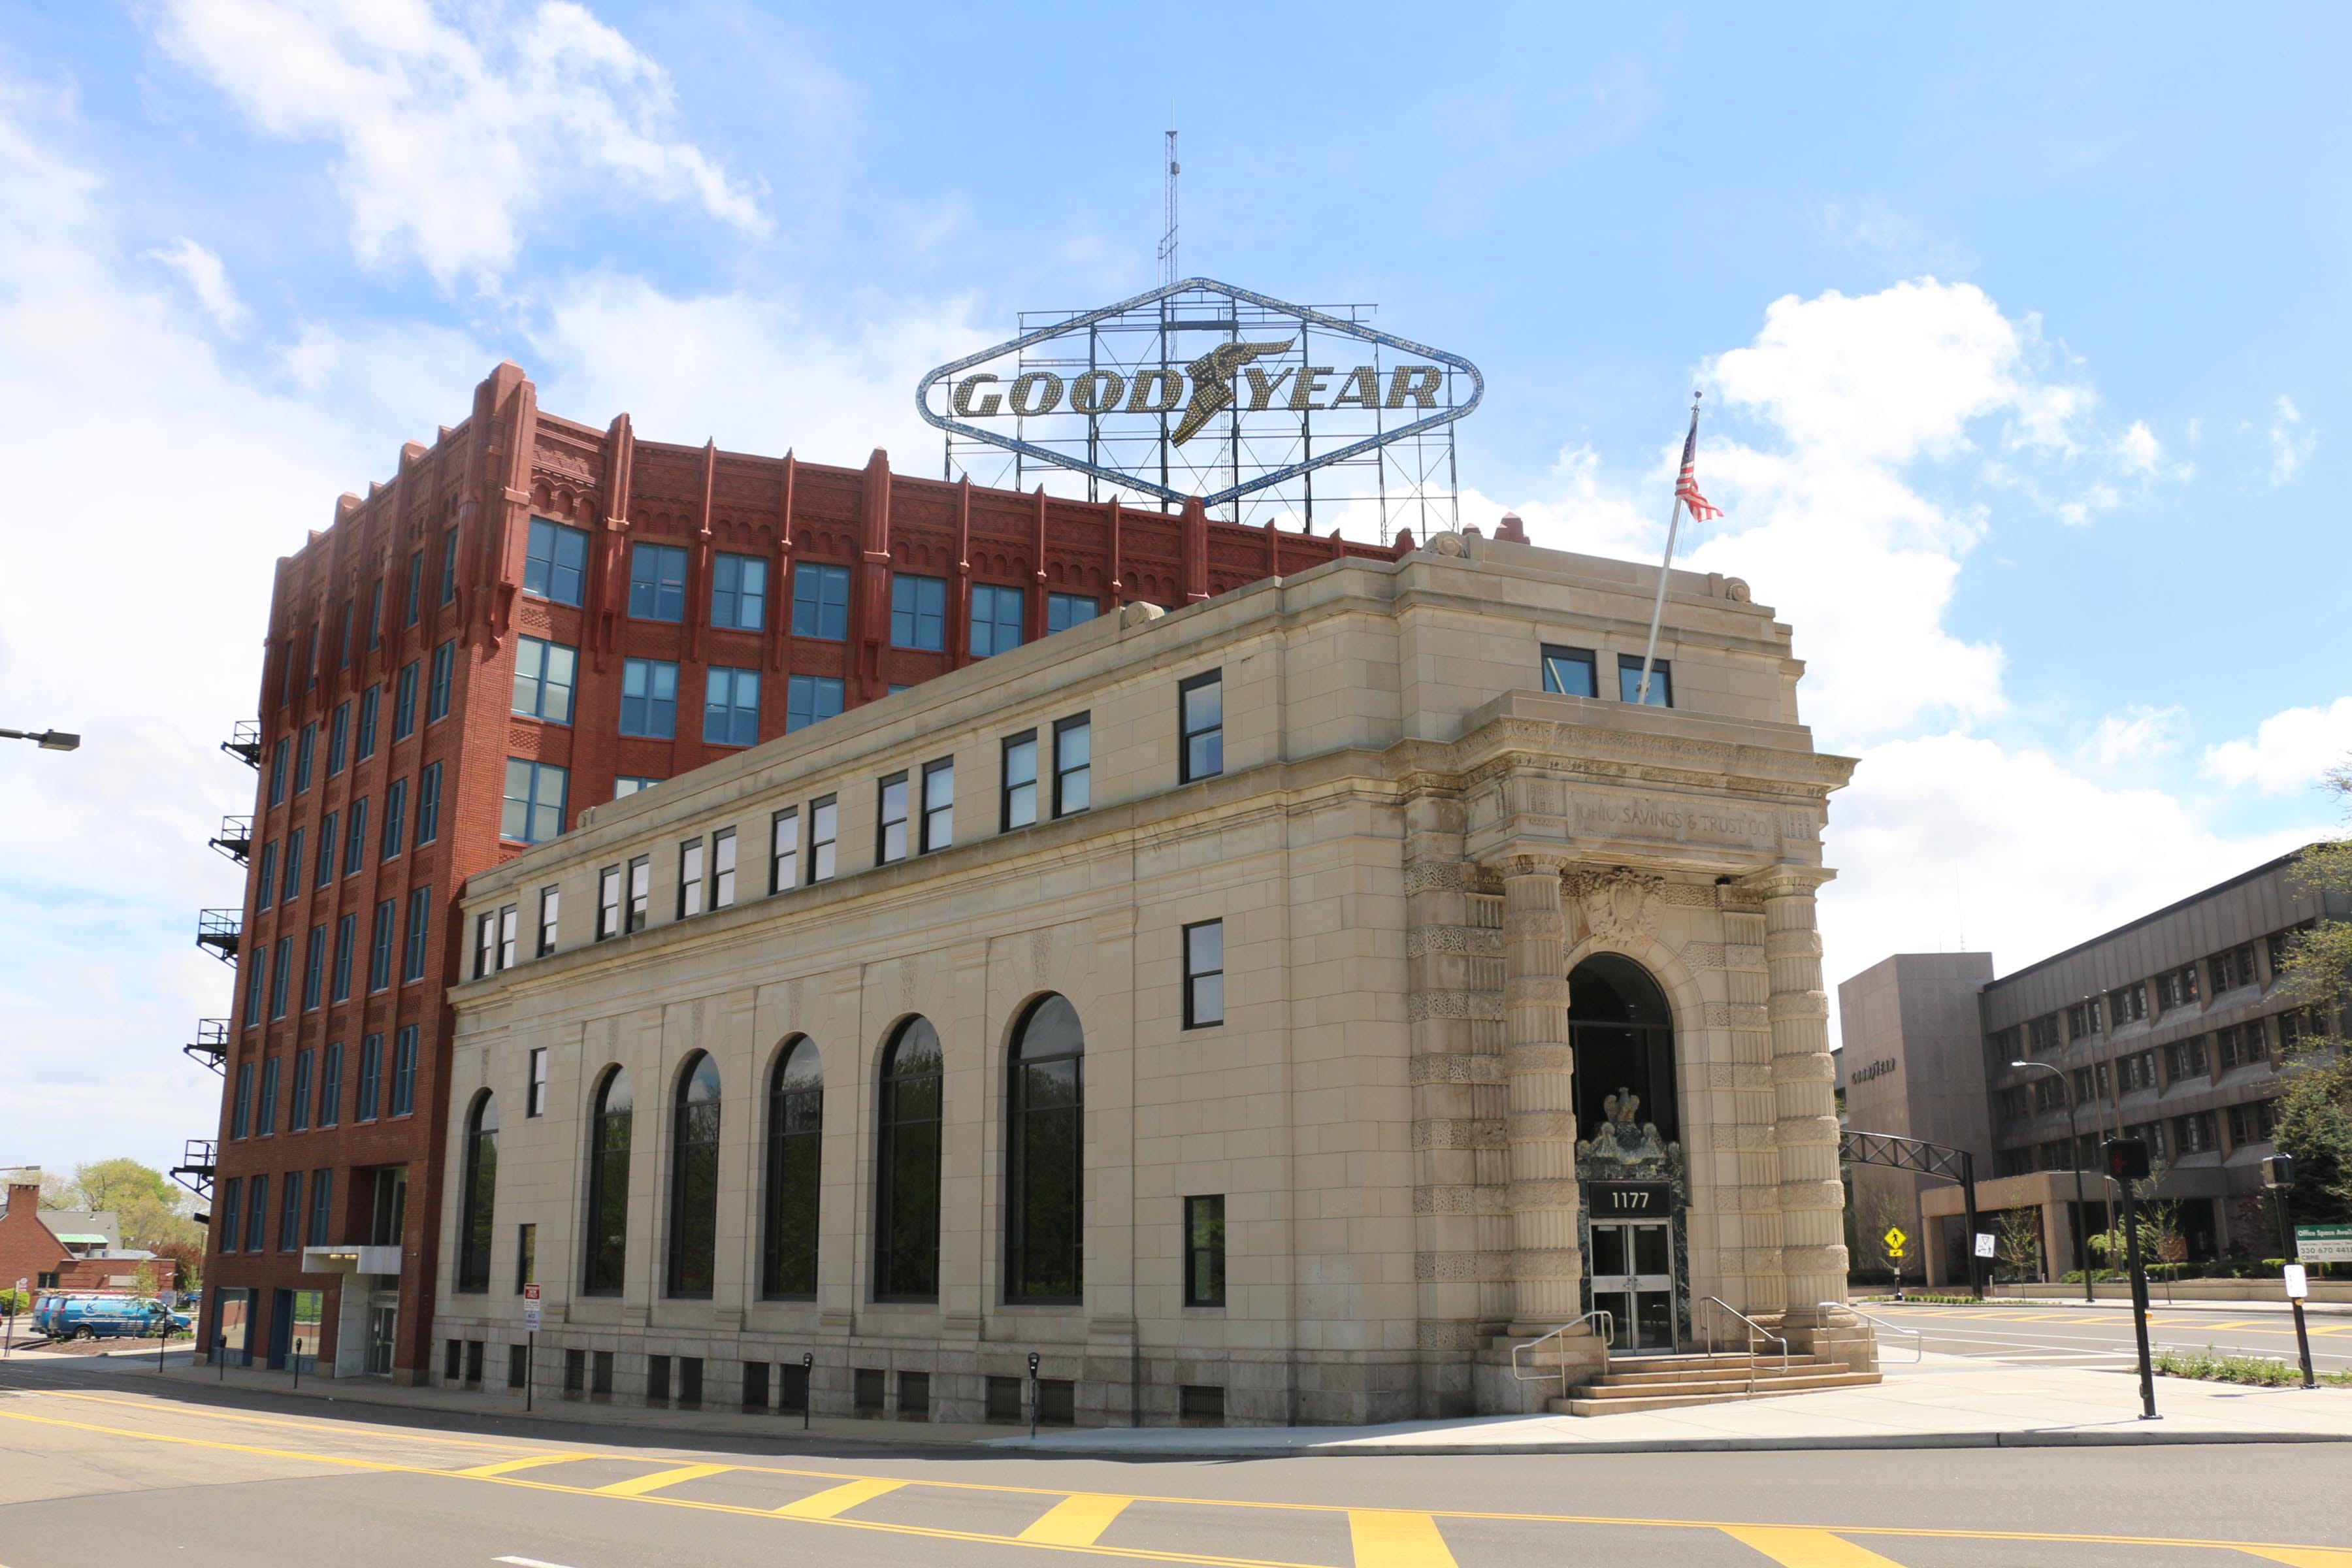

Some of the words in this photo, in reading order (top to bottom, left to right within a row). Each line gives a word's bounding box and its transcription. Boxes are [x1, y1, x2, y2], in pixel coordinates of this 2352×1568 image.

[953, 365, 1443, 417] GOODYEAR
[1580, 804, 1617, 822] OHIO
[1623, 806, 1683, 828] SAVINGS
[1688, 815, 1697, 830] &
[1700, 815, 1744, 834] TRUST
[1612, 1192, 1650, 1209] 1177
[2316, 1229, 2336, 1237] Space
